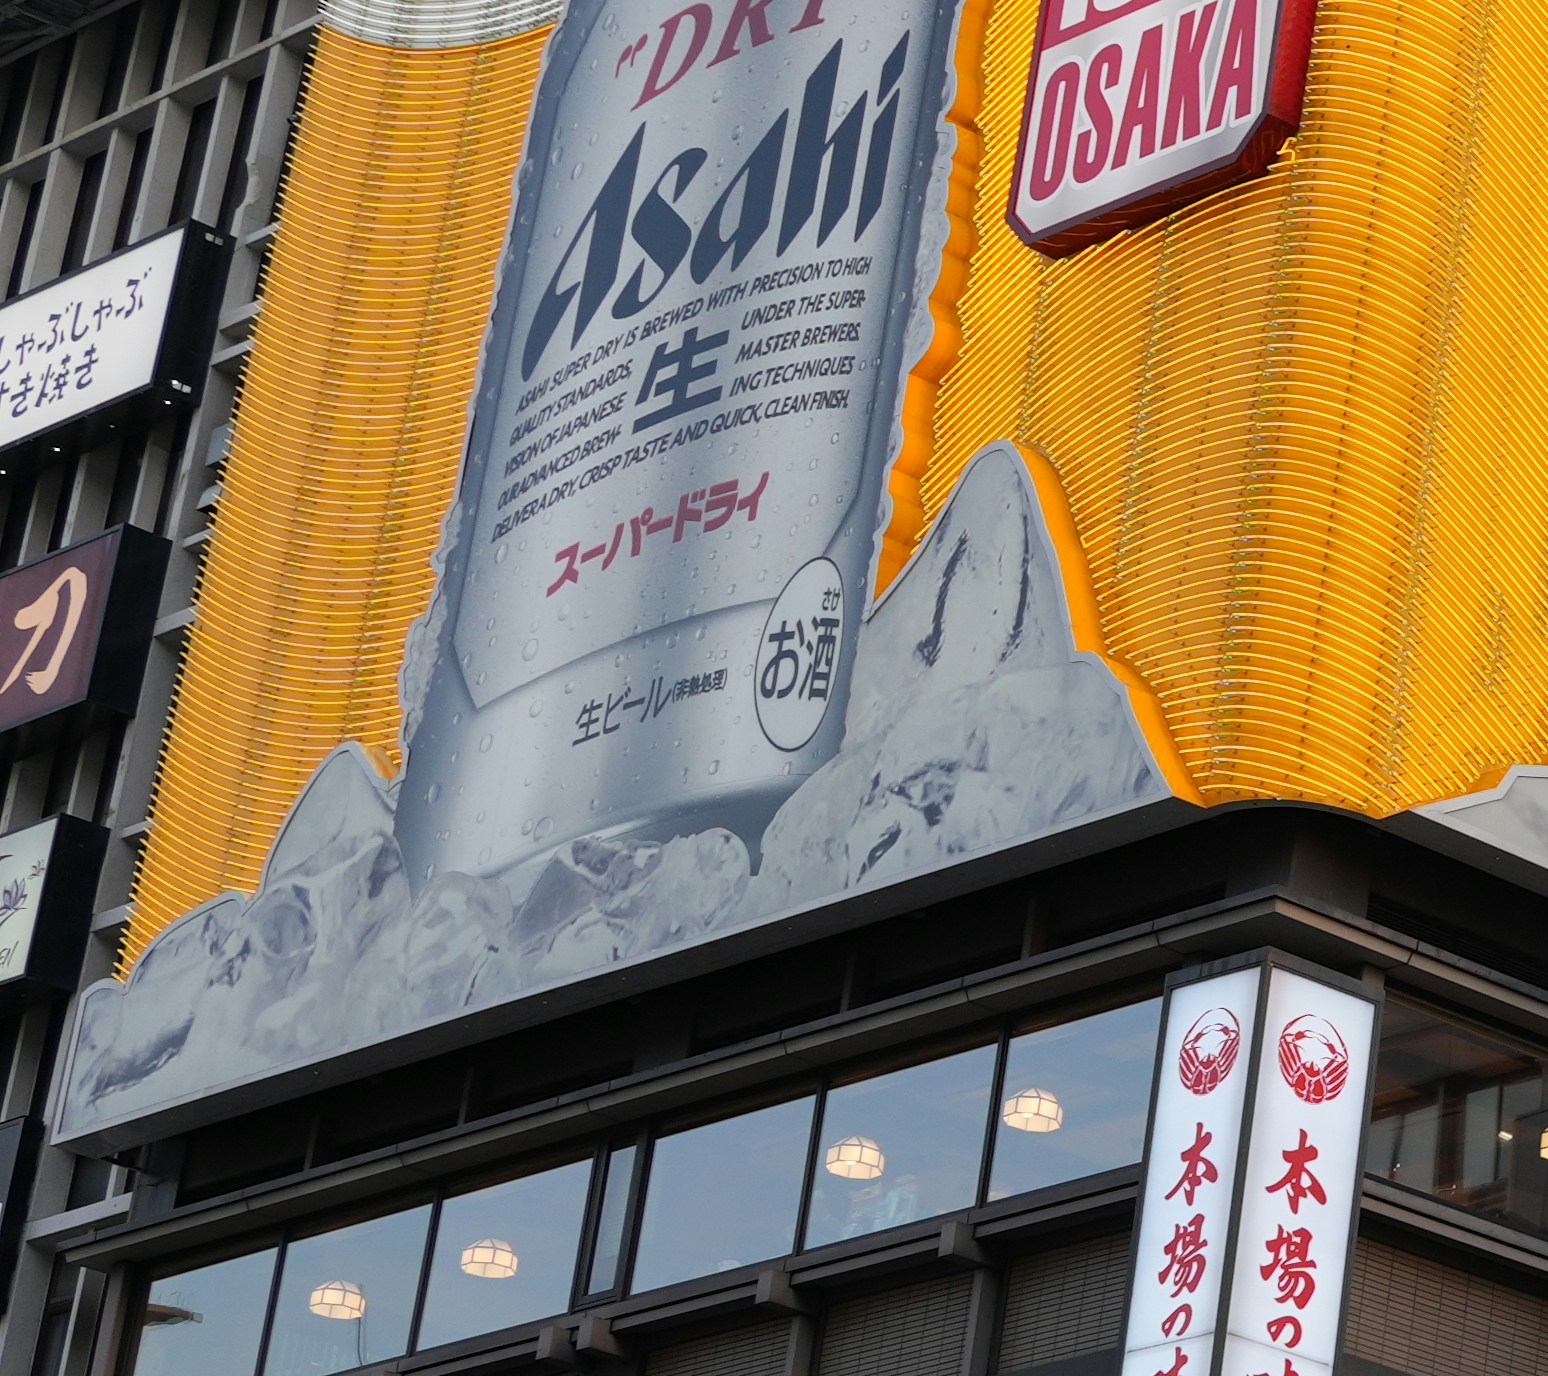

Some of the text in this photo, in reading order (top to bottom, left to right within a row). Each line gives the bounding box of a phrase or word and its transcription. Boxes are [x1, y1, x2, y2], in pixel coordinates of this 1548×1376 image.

[522, 29, 910, 383] Asahi
[515, 256, 872, 415] ASAHI SUPER DRY IS BREWED WITH PRECISION TO HIGH
[632, 329, 730, 434] 生
[728, 355, 855, 398] ING TECHNIQUES
[546, 471, 769, 598] スーパードライ
[821, 587, 841, 612] さけ
[760, 616, 840, 701] お酒
